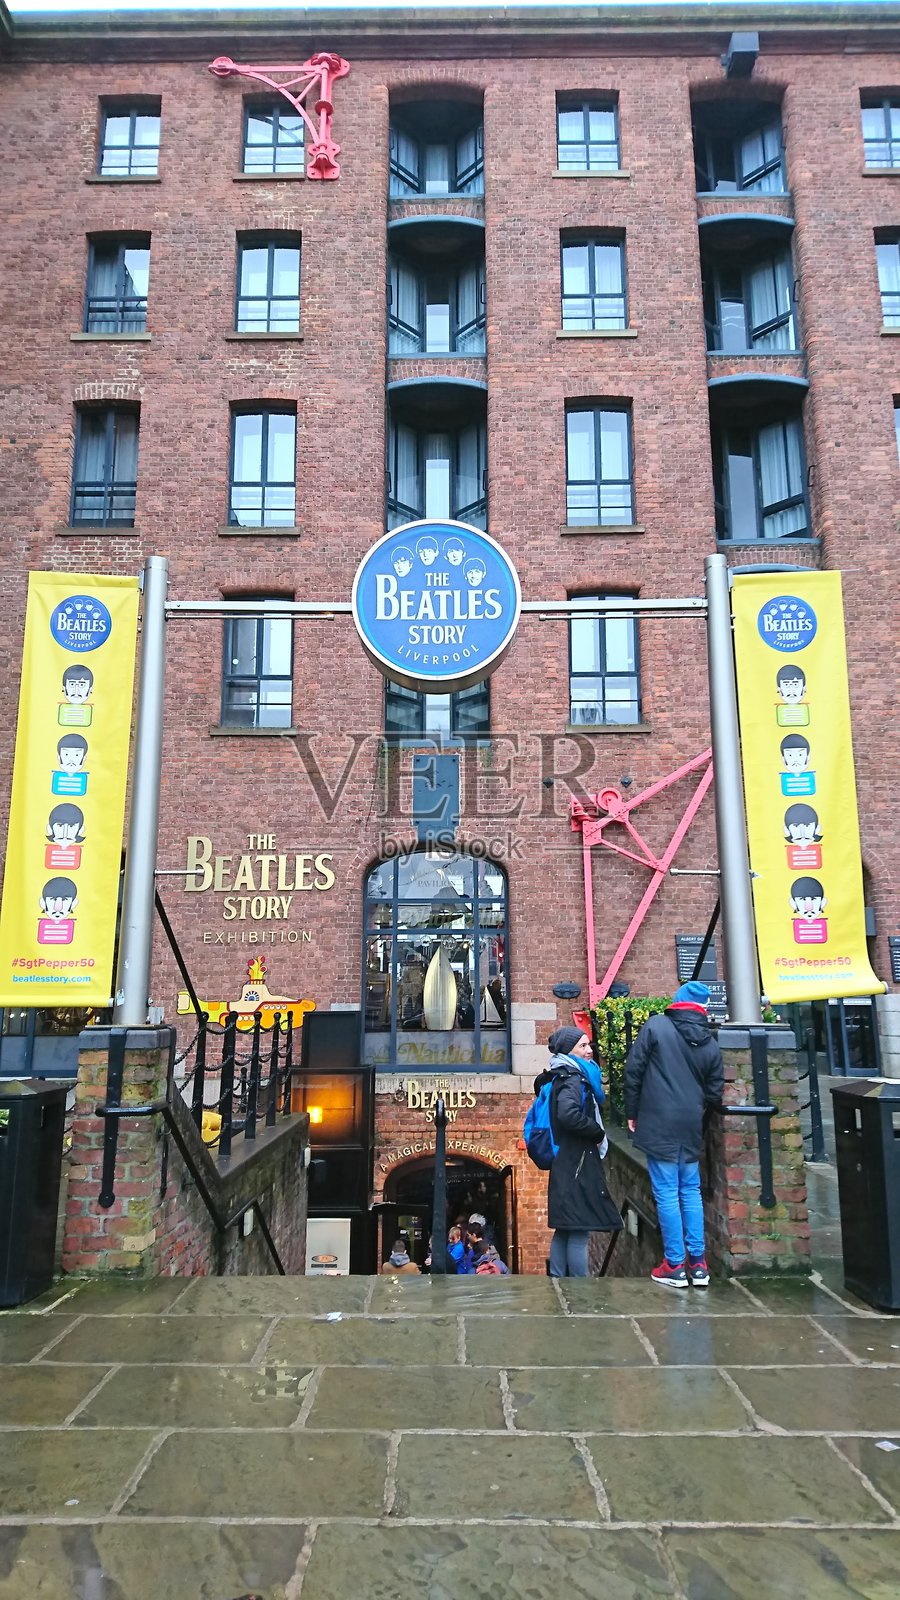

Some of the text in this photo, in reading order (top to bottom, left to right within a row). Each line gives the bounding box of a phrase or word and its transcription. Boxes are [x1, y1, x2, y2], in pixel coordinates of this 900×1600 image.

[425, 572, 450, 587] THE
[375, 574, 503, 621] BEATLES
[57, 613, 106, 631] BEATLES
[763, 614, 813, 631] BEATLES
[69, 632, 92, 640] STORY
[408, 625, 467, 645] STORY
[777, 632, 799, 640] STORY
[64, 640, 97, 648] LIVERPOOL
[397, 644, 480, 665] LIVERPOOL
[247, 834, 277, 850] THE
[184, 836, 336, 892] BEATLES
[222, 895, 293, 920] STORY
[203, 930, 313, 944] EXHIBITION
[12, 958, 95, 969] #SgtPepper50
[774, 956, 852, 968] #SgtPepper50
[12, 975, 91, 984] beatlesstory.com
[435, 1079, 449, 1088] THE
[407, 1080, 477, 1109] BEATLES
[426, 1110, 458, 1123] SRY
[379, 1140, 507, 1172] A MAGICAL XPERIENCE
